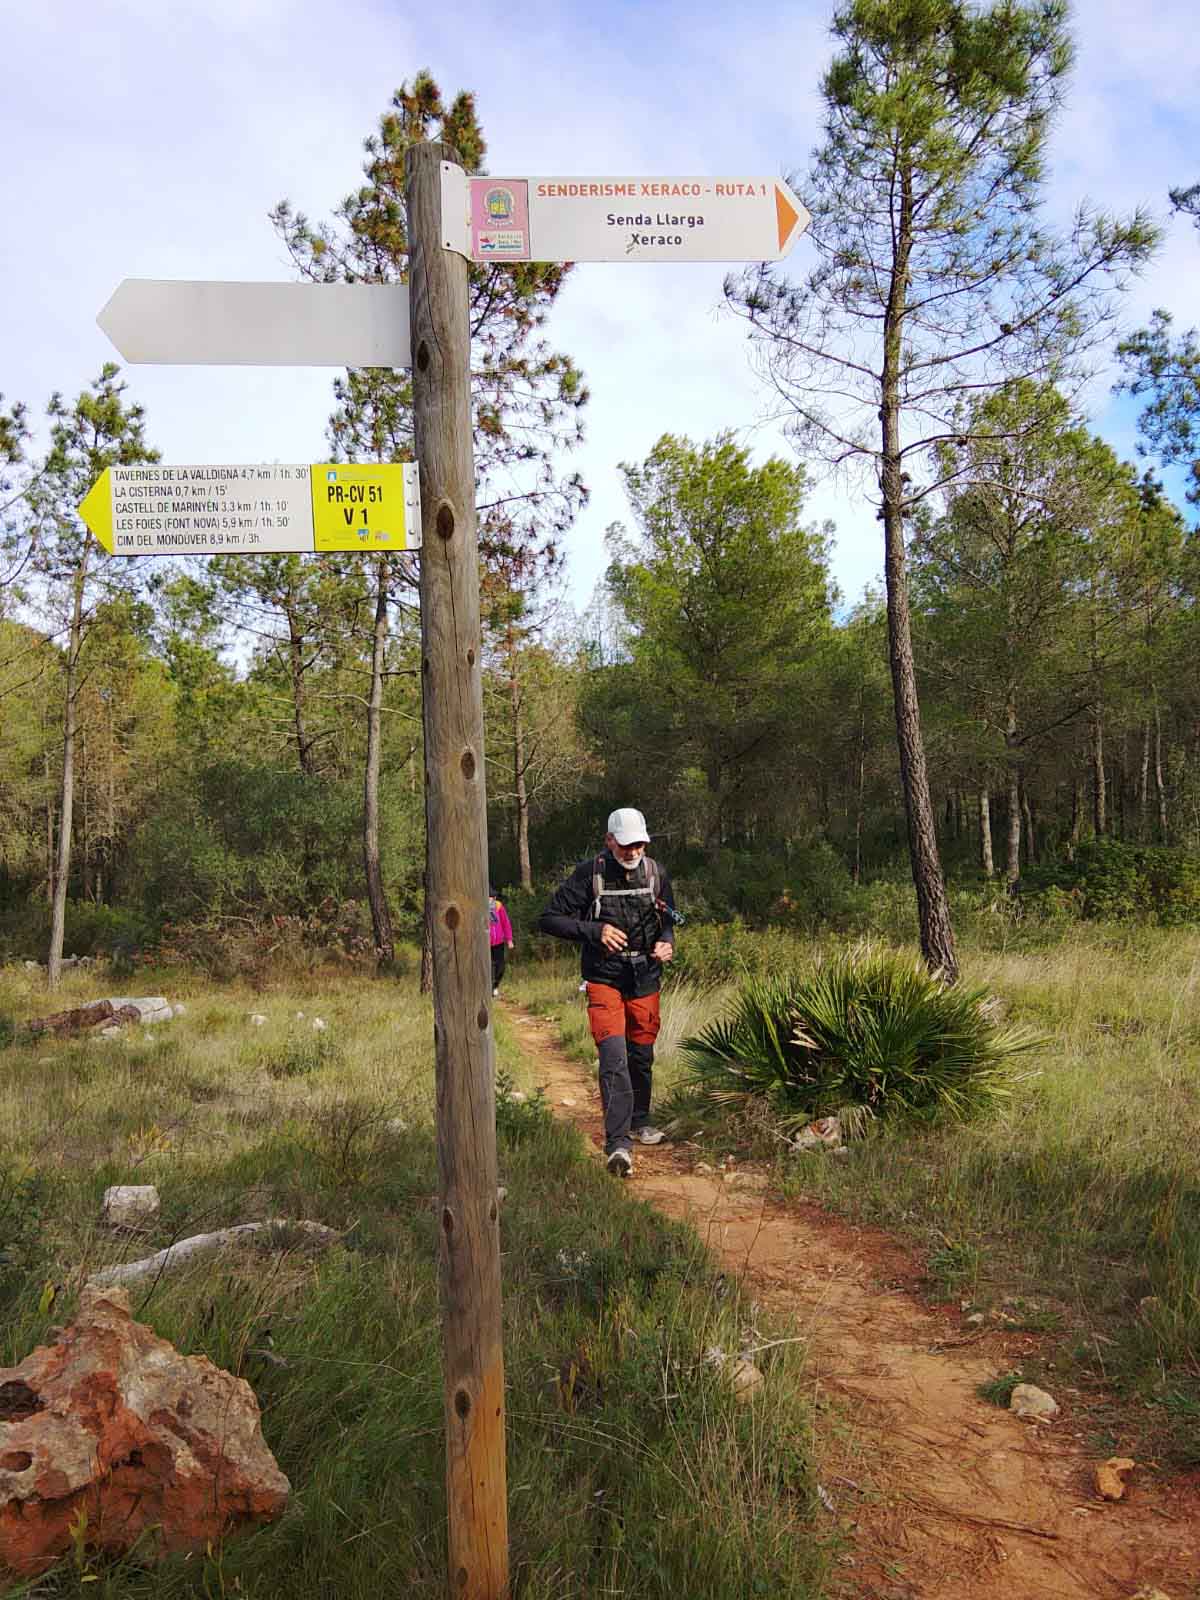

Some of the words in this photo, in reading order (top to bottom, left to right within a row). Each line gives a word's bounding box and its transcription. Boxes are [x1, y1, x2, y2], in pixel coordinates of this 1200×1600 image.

[537, 184, 636, 196] SENDERISME
[640, 184, 700, 196] XERACO
[715, 184, 755, 196] RUTA
[759, 184, 766, 195] 1
[607, 214, 652, 225] Senda
[656, 213, 704, 228] Llarga
[631, 233, 682, 245] Xeraco
[114, 470, 160, 481] TAVERNES
[162, 470, 175, 480] DE
[177, 469, 188, 480] LA
[190, 469, 238, 480] VALLDIGNA
[241, 469, 255, 481] 4,7
[257, 469, 271, 479] km
[115, 487, 126, 497] LA
[128, 486, 174, 497] CISTERNA
[175, 486, 189, 497] 0,7
[192, 486, 206, 496] km
[327, 485, 365, 503] PR-CV
[368, 485, 382, 503] 51
[115, 502, 155, 513] CASTELL
[157, 502, 171, 513] DE
[237, 501, 251, 512] km
[343, 508, 354, 526] V
[360, 508, 368, 525] 1
[116, 519, 133, 530] LES
[136, 519, 162, 529] FOIES
[165, 518, 190, 531] (FONT
[193, 517, 219, 529] NOVA)
[222, 517, 236, 529] 5,9
[239, 517, 252, 528] km
[117, 535, 134, 546] CIM
[136, 535, 153, 546] DEL
[210, 534, 224, 545] 8,9
[226, 534, 240, 544] km
